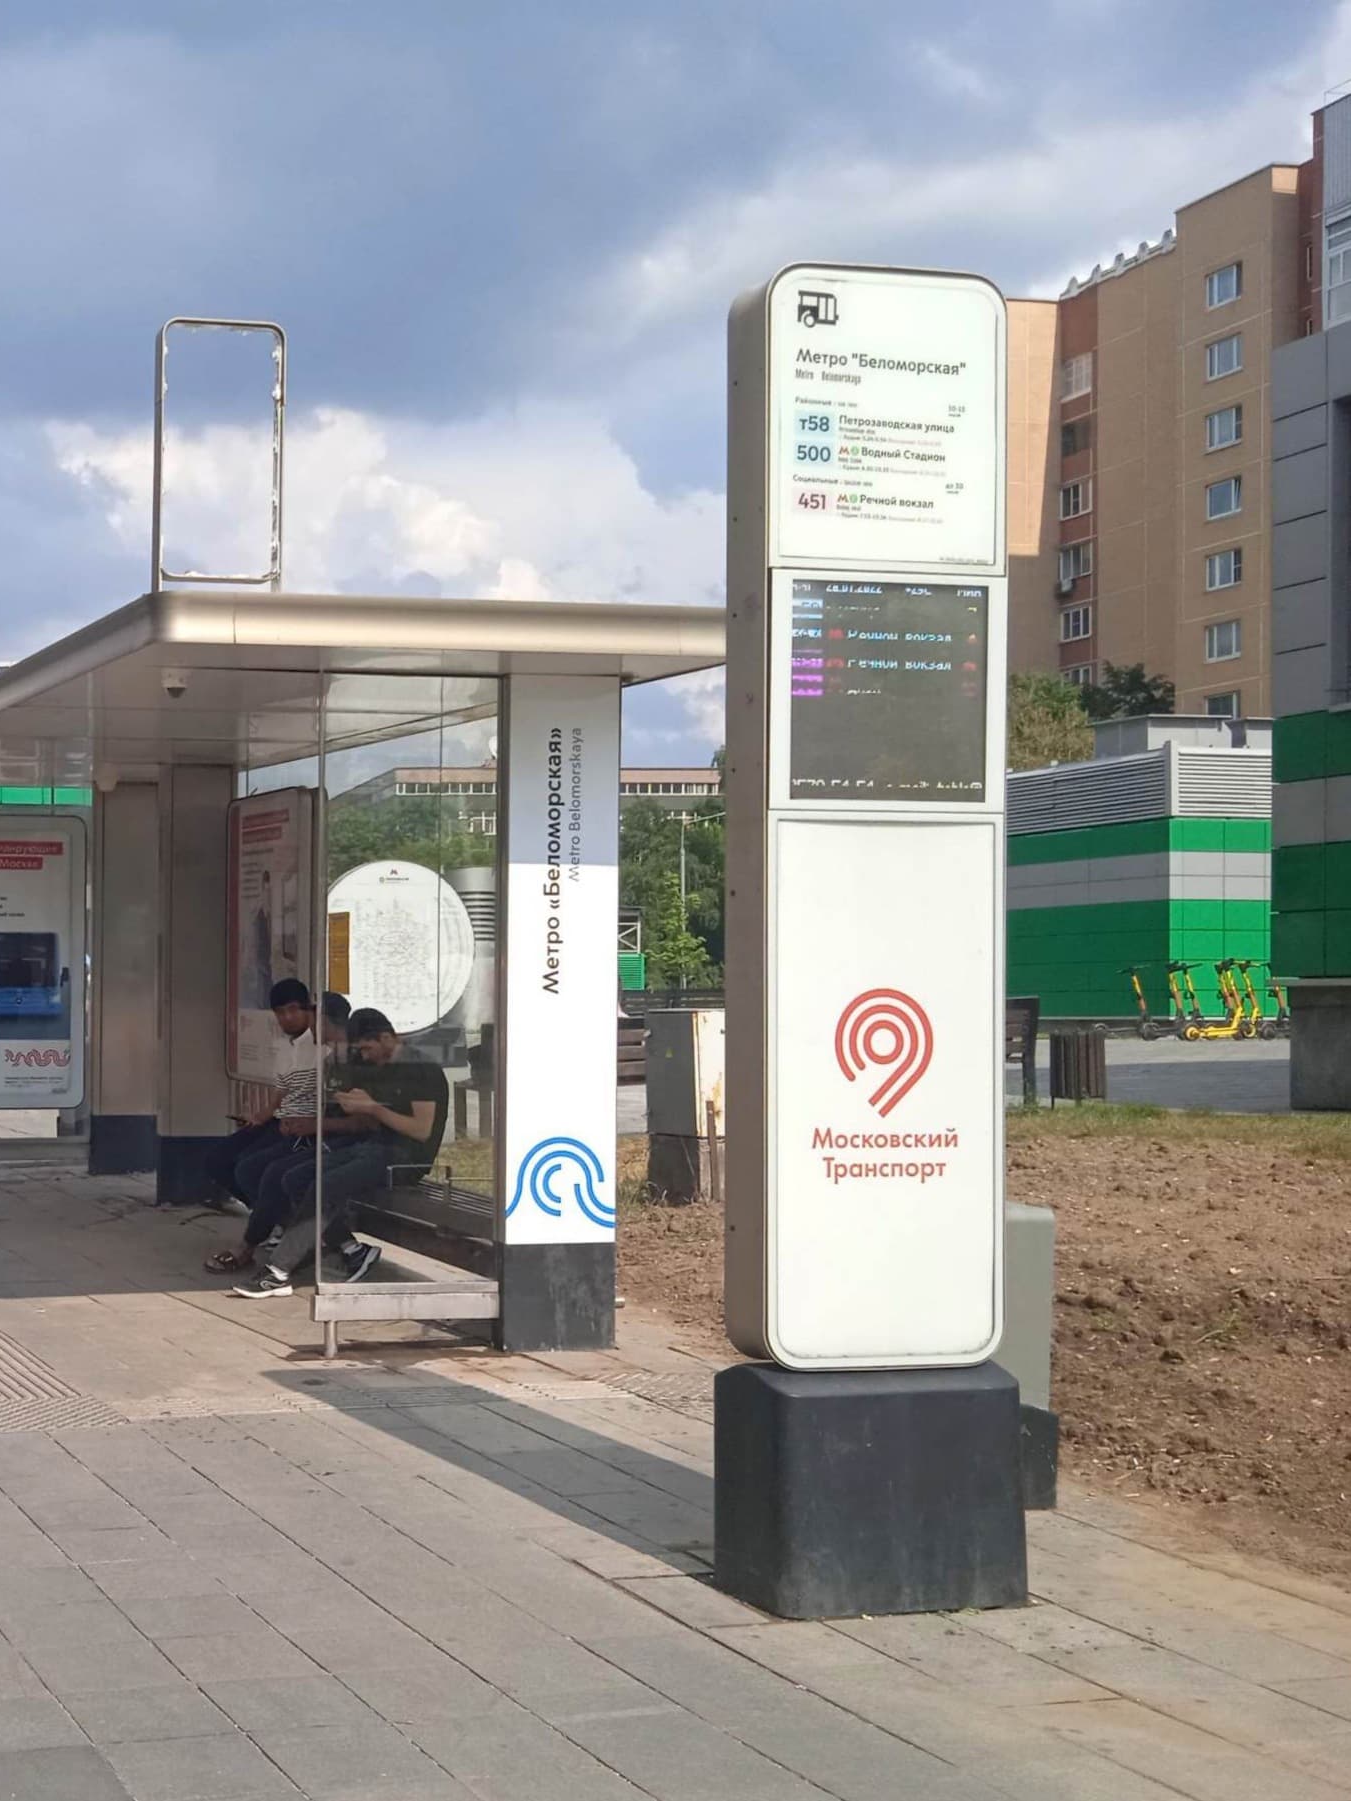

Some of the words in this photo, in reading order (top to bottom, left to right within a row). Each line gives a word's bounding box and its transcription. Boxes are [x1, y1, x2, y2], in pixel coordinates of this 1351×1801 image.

[796, 348, 848, 367] Метро
[851, 353, 966, 375] "Беломорская"
[839, 414, 922, 431] Петрозаводская
[924, 422, 955, 434] улица
[796, 445, 831, 462] 500
[861, 447, 901, 460] Водный
[903, 450, 946, 463] Стадион
[798, 492, 827, 510] 451
[860, 494, 896, 506] Речной
[899, 499, 934, 509] вокзал
[569, 728, 584, 829] Belomorskaya
[543, 728, 565, 910] «Беломорская»
[569, 836, 581, 882] Metro
[542, 917, 564, 994] Метро
[812, 1127, 958, 1149] Московский
[822, 1156, 947, 1185] Транспорт
